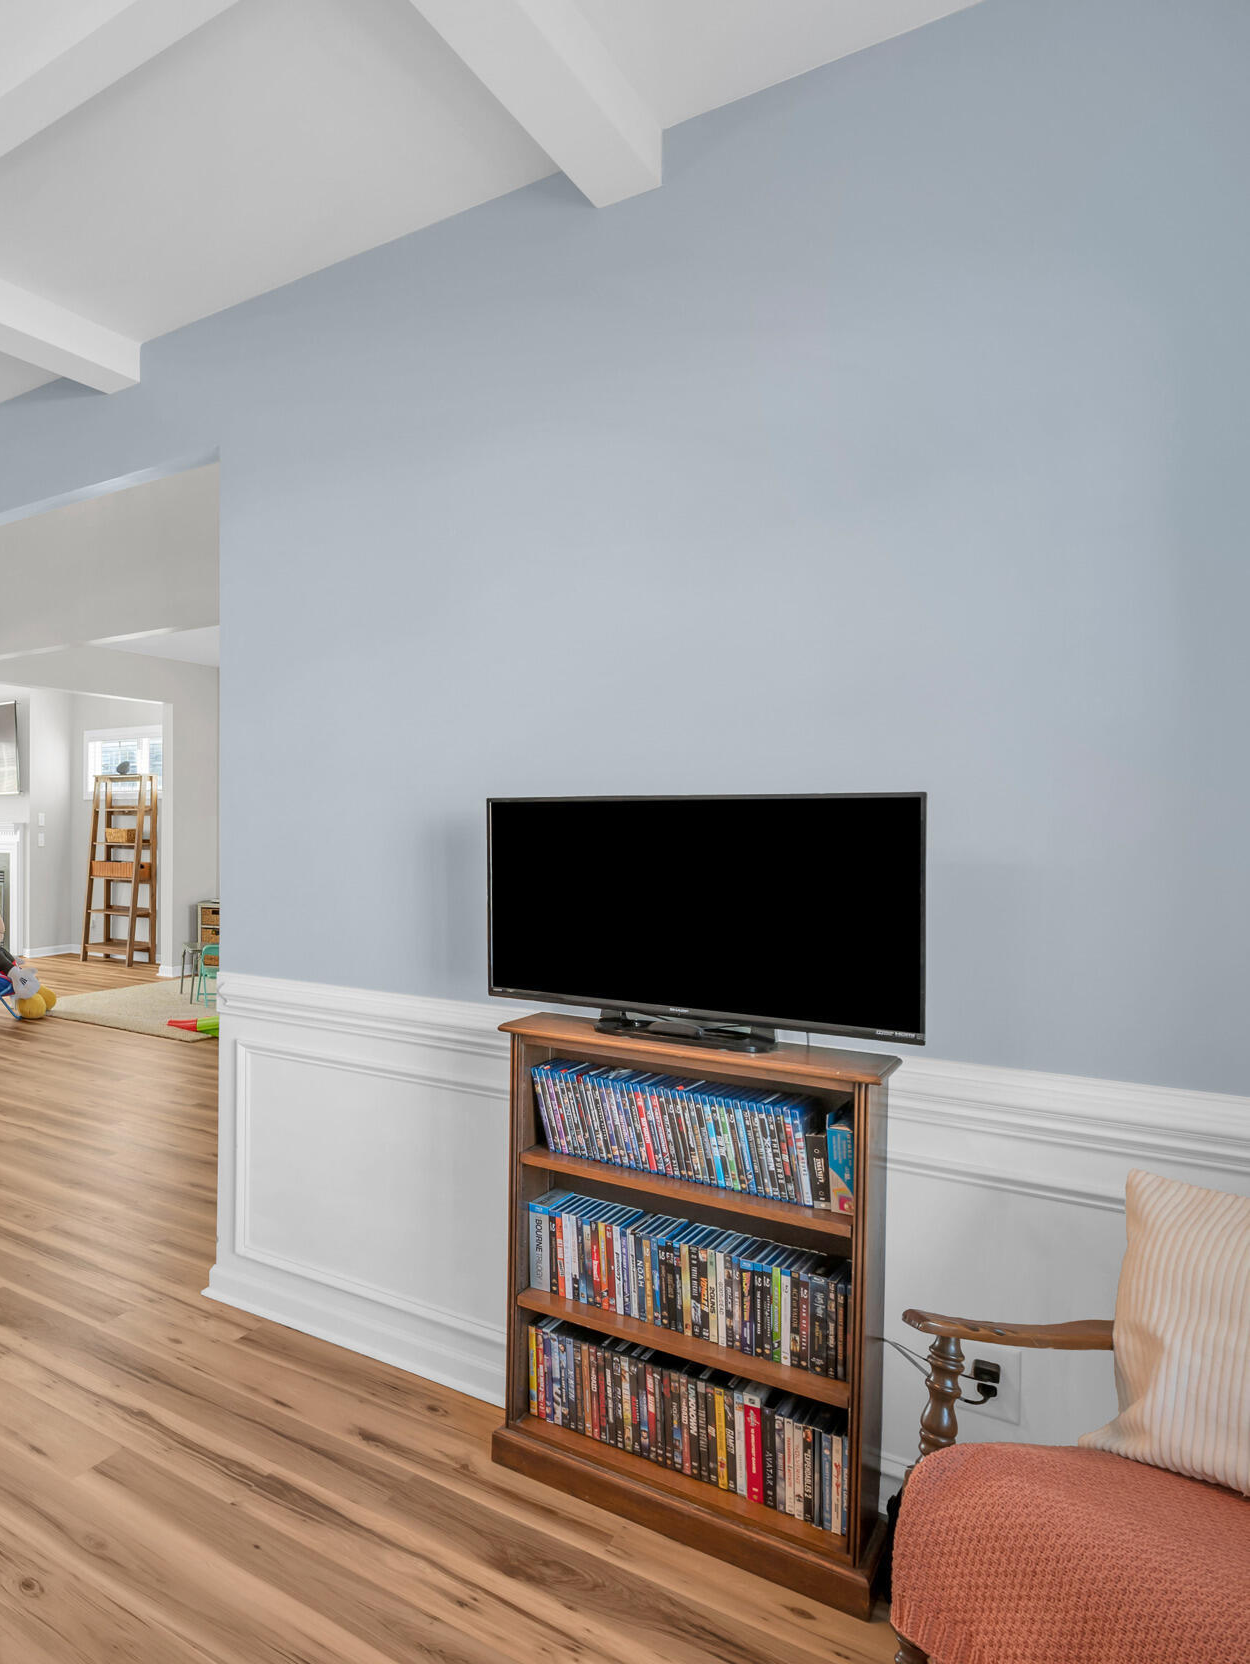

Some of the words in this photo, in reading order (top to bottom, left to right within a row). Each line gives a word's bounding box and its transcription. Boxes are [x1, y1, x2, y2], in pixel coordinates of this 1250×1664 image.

[535, 1218, 543, 1252] BOURNE
[535, 1252, 543, 1280] TRILOGY
[688, 1383, 698, 1436] UNKNOWN
[765, 1450, 774, 1487] AVATAR
[803, 1452, 812, 1492] EXPENDABLES
